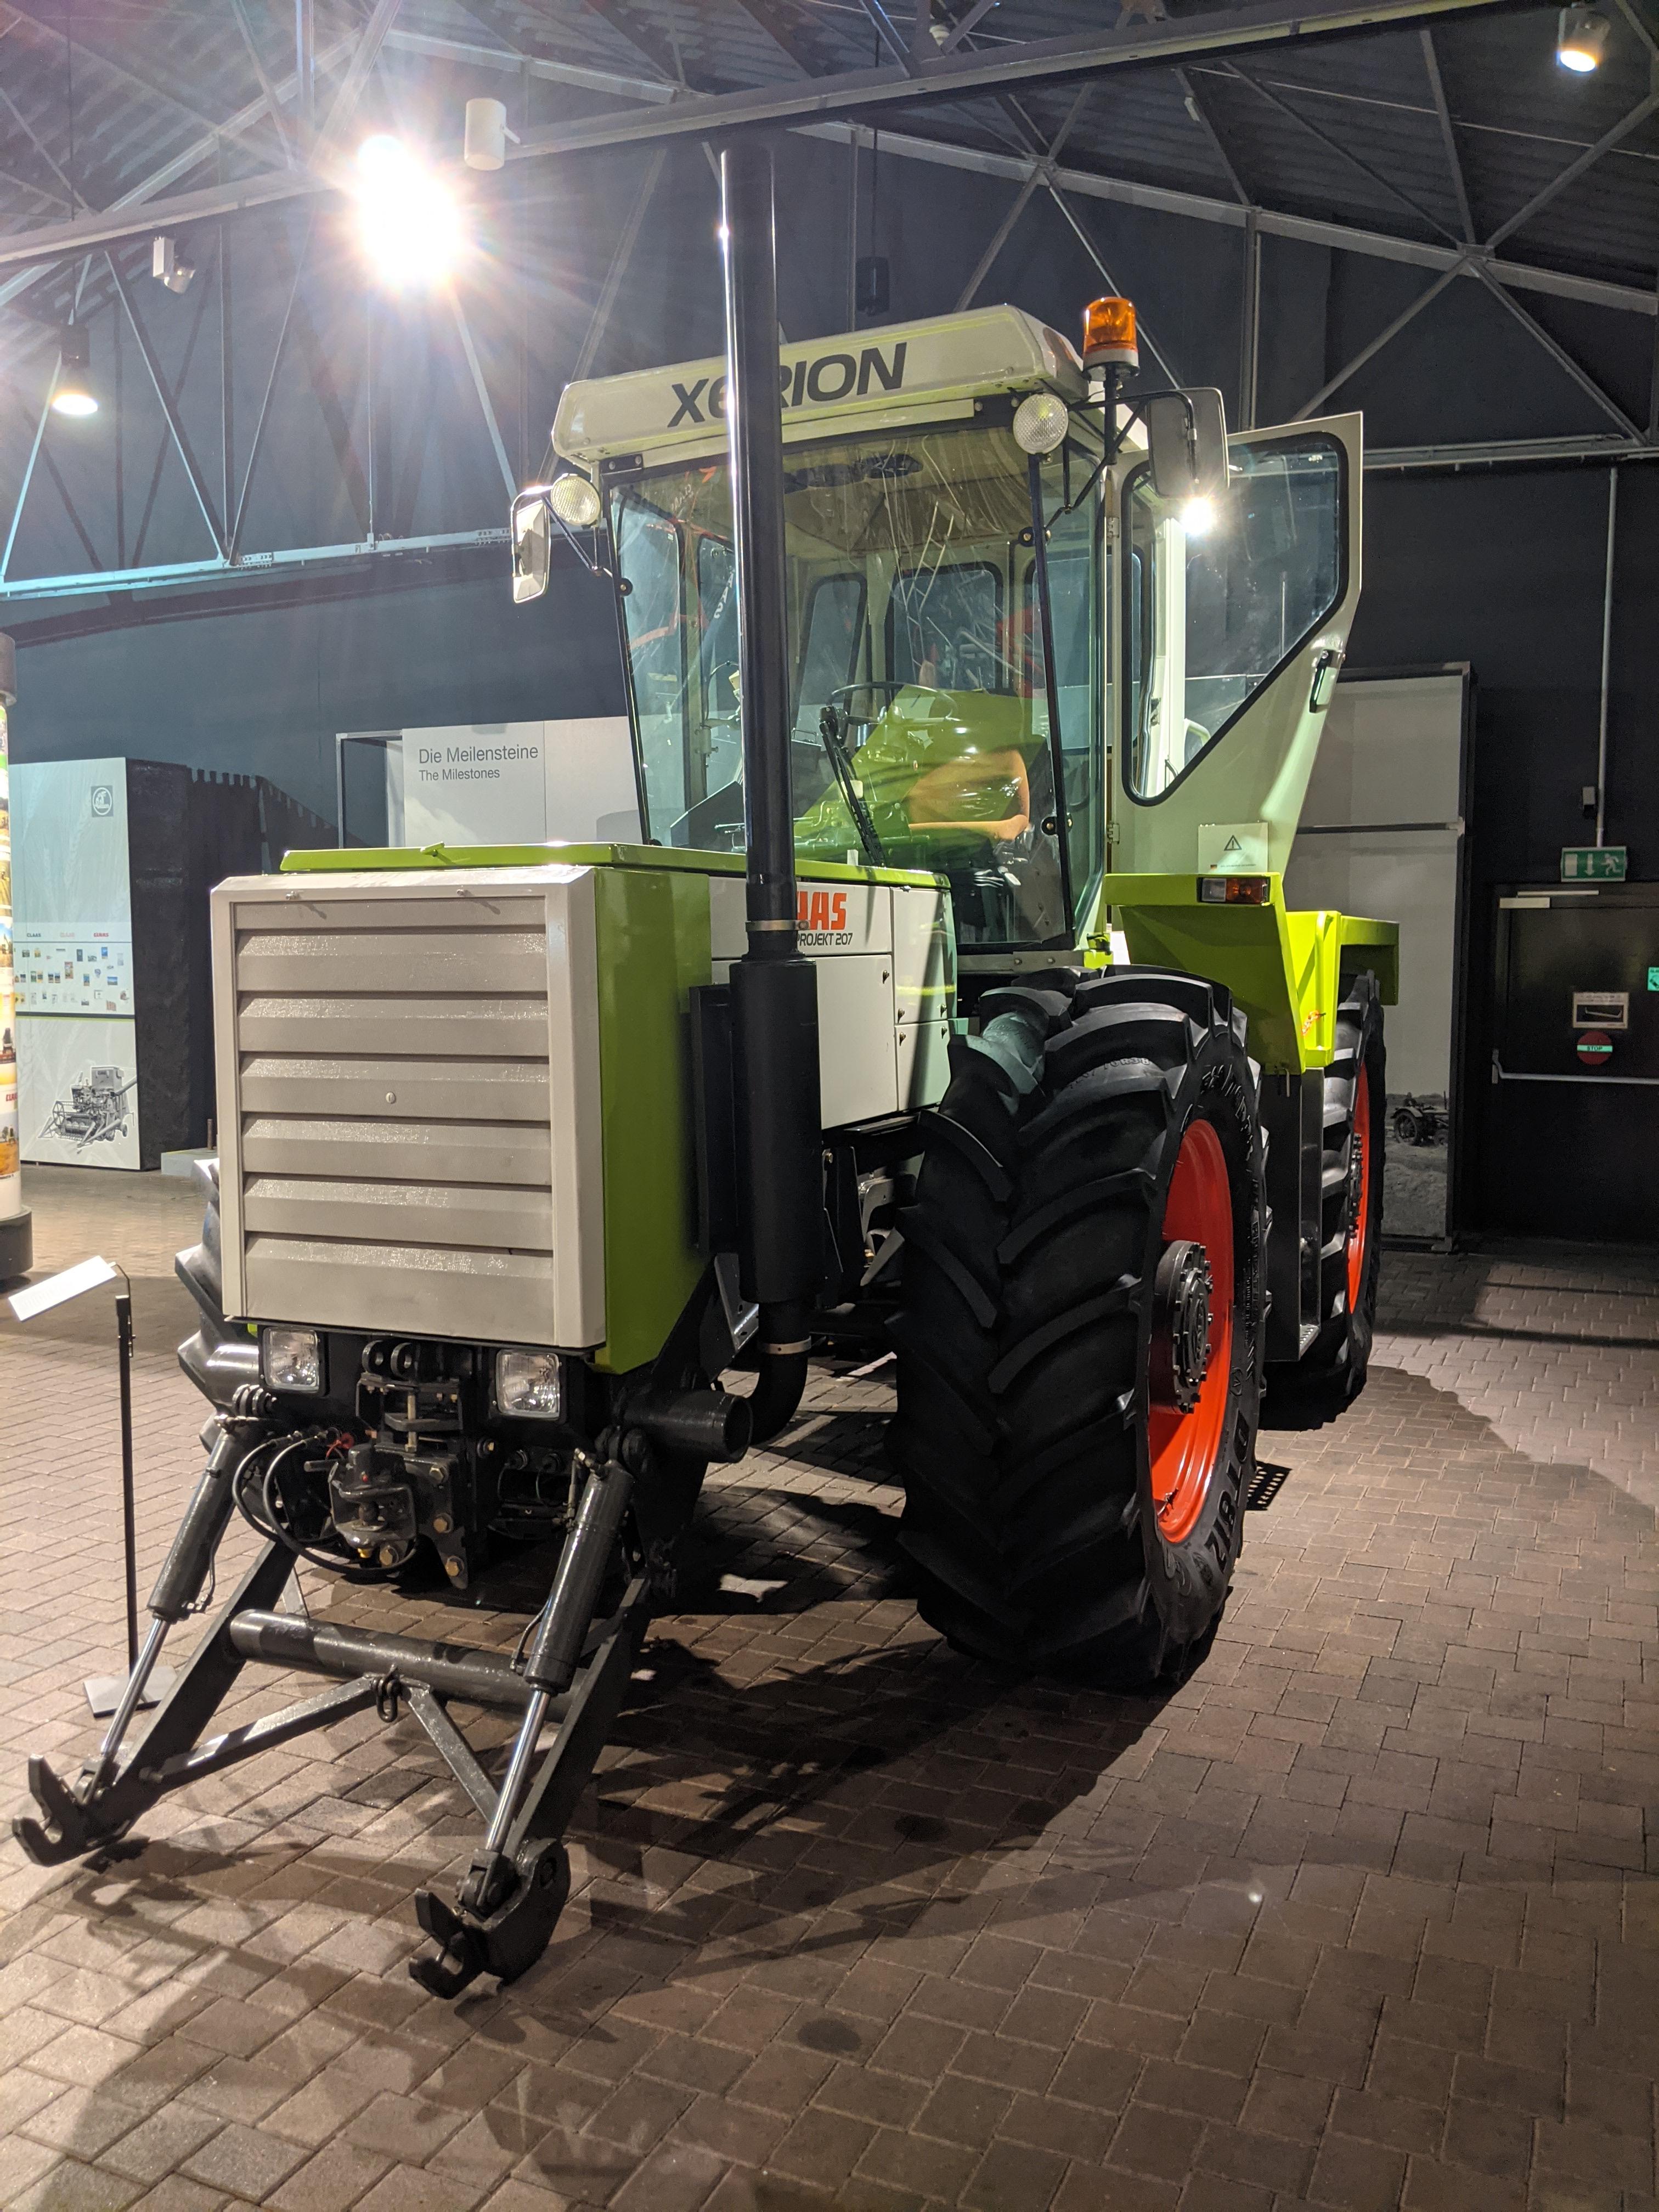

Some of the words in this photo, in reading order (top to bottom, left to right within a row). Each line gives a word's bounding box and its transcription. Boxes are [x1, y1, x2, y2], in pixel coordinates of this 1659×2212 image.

[419, 748, 442, 764] Die
[447, 744, 538, 763] Meilensteine
[419, 770, 439, 781] The
[442, 769, 500, 780] Milestones
[835, 933, 853, 945] 207
